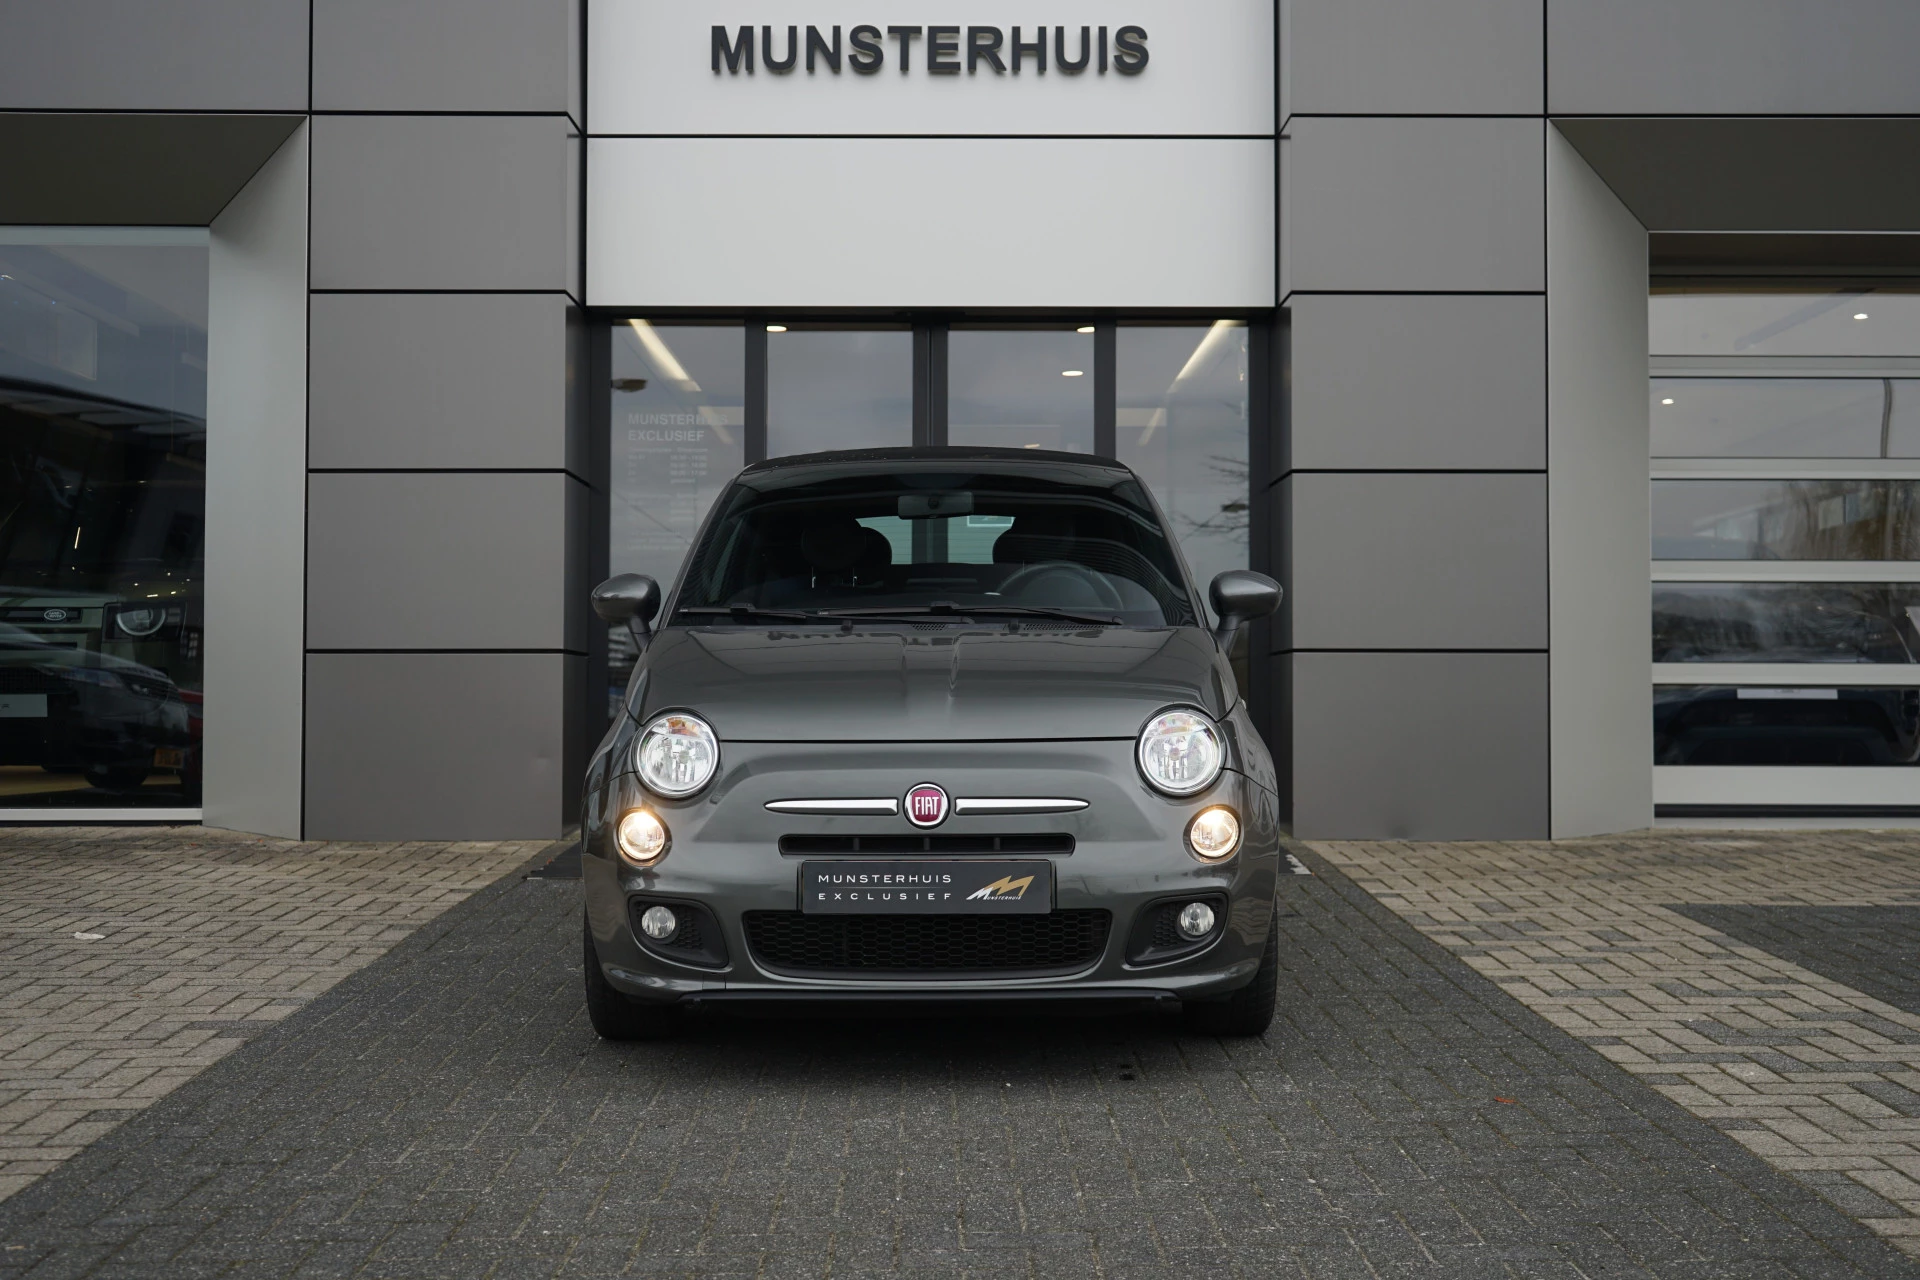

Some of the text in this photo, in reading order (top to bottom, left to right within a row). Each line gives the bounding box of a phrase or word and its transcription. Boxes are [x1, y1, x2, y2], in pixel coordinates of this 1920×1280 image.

[711, 25, 1149, 74] MUNSTERHUIS
[628, 413, 728, 425] MUNSTERHS
[628, 430, 705, 442] EXCLUSIEF
[914, 796, 940, 816] FIAT
[818, 874, 952, 884] MUNSTERHUIS
[818, 892, 952, 901] EXCLUSIEF
